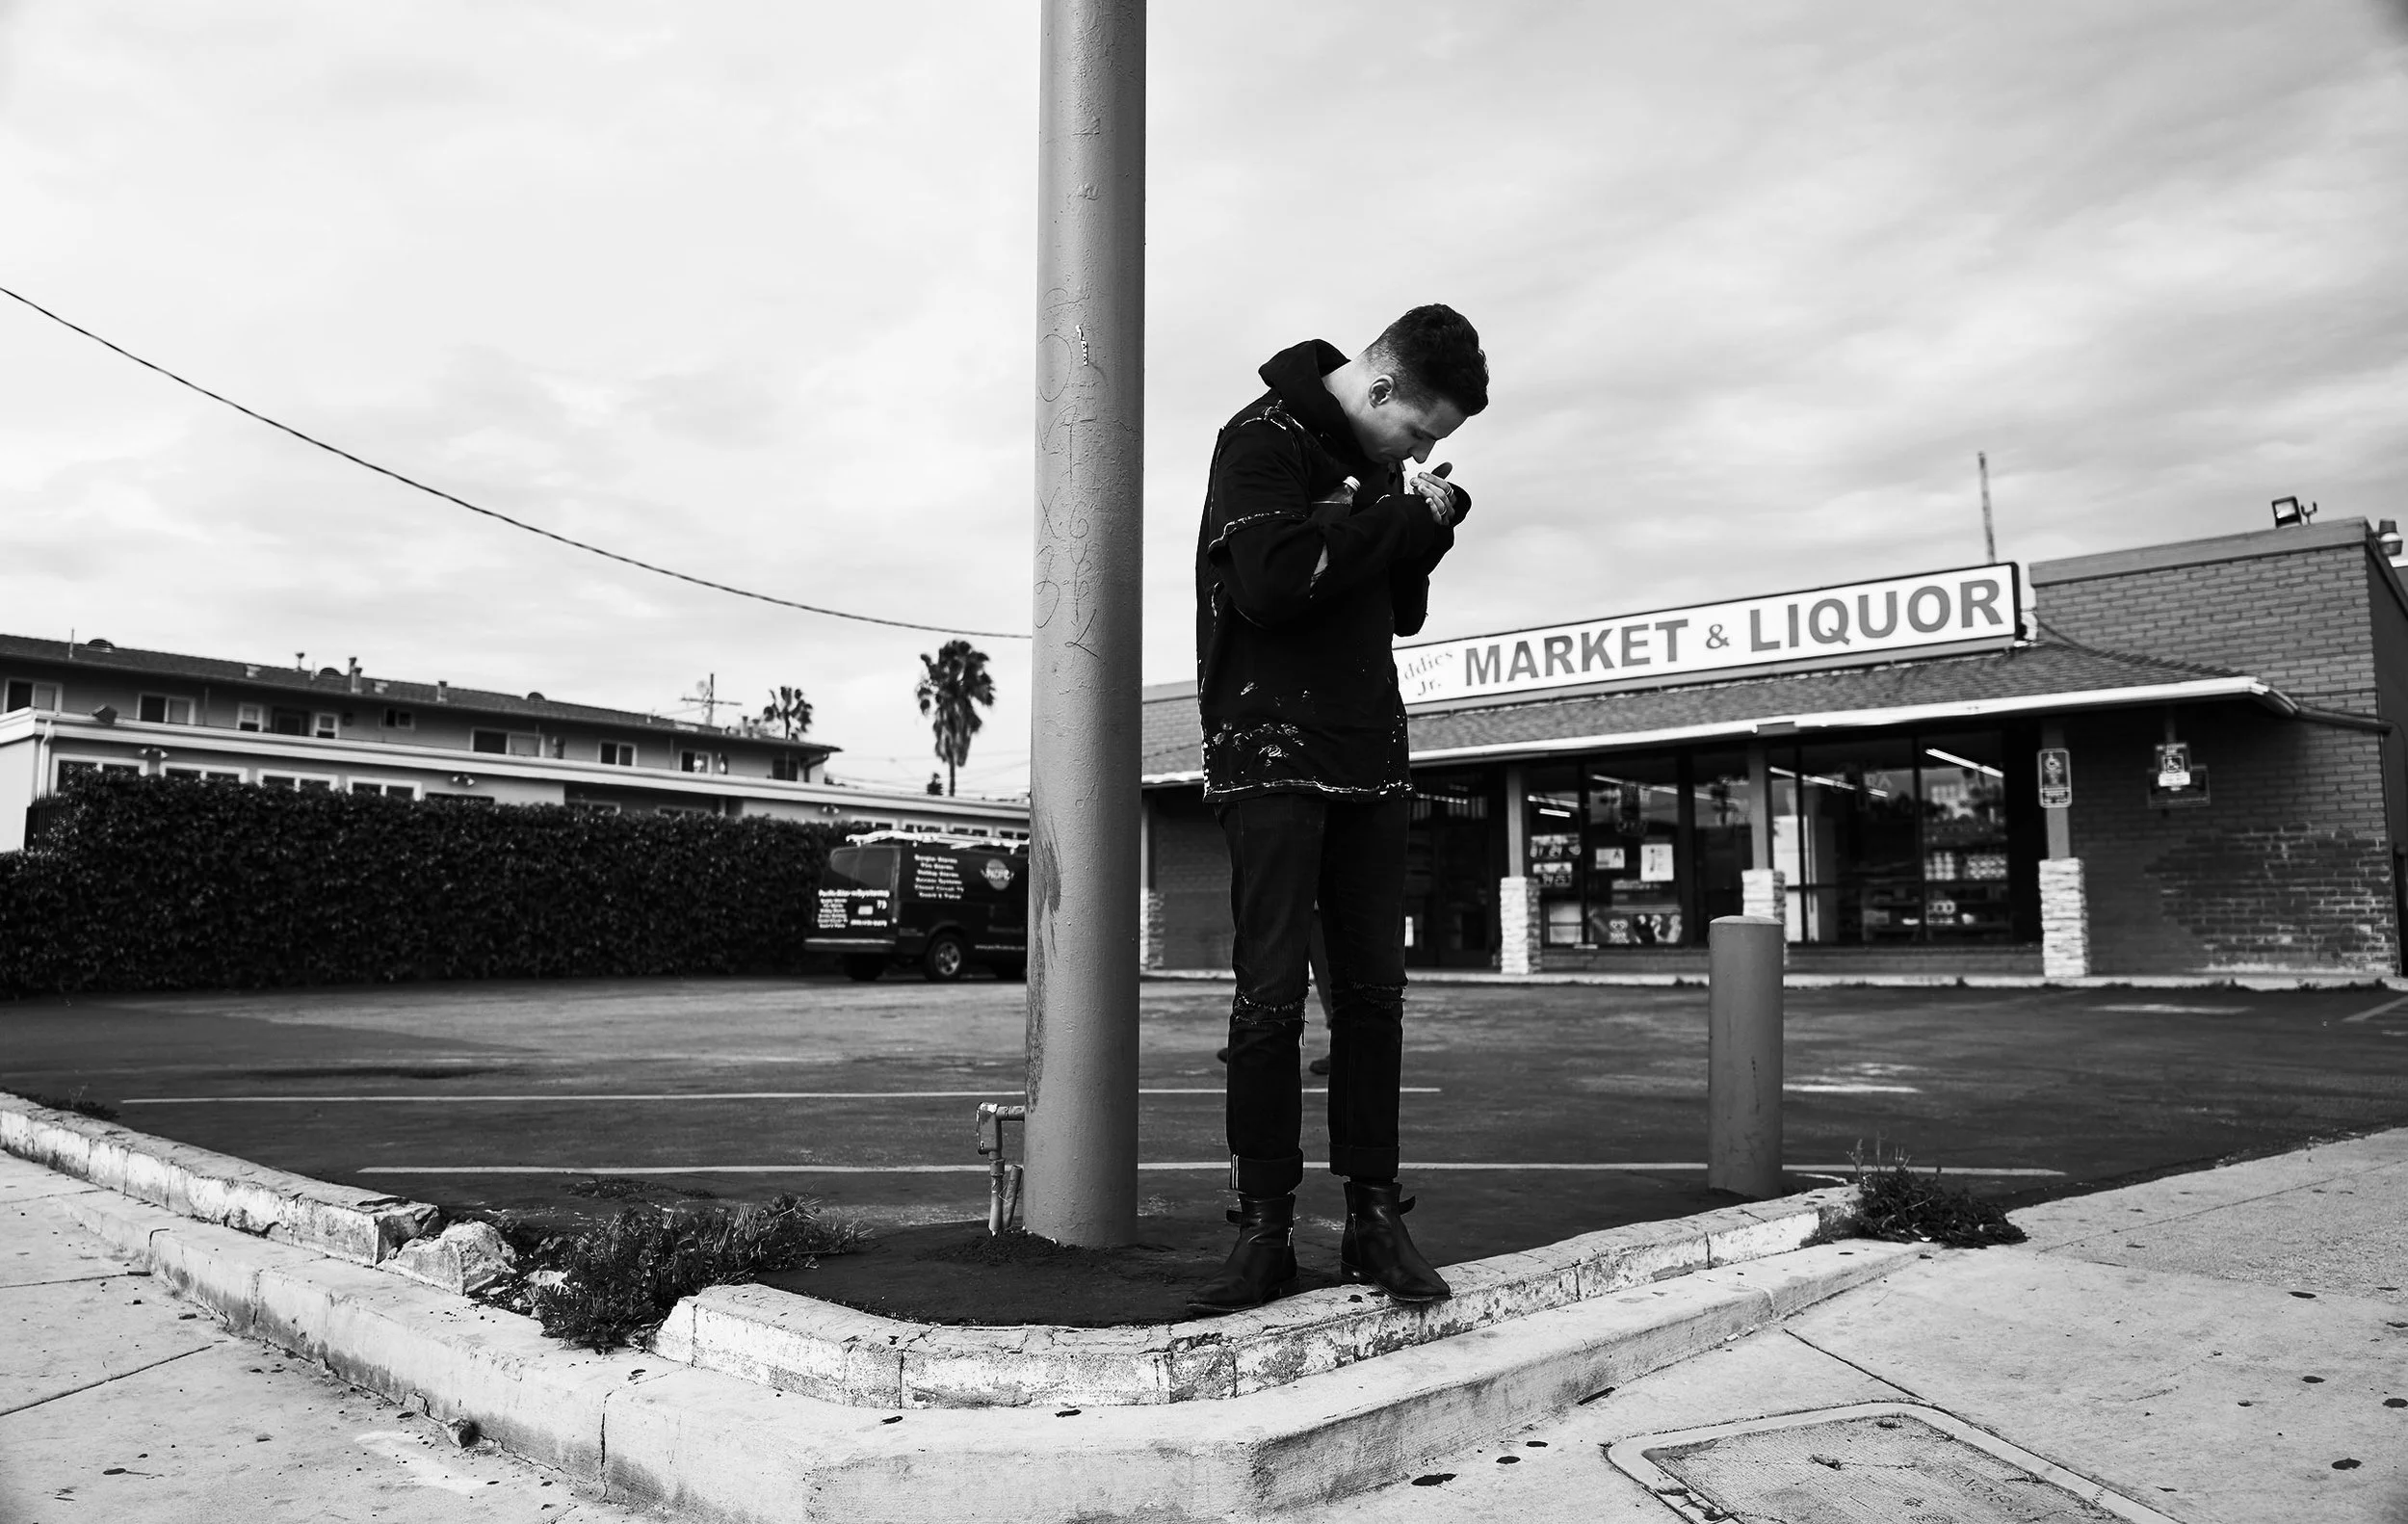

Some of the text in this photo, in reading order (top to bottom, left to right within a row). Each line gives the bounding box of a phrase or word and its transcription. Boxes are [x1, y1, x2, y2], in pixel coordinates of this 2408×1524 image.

[1464, 578, 2004, 687] MARKET & LIQUOR
[1403, 652, 1453, 680] ddies
[1418, 677, 1441, 696] Jr.
